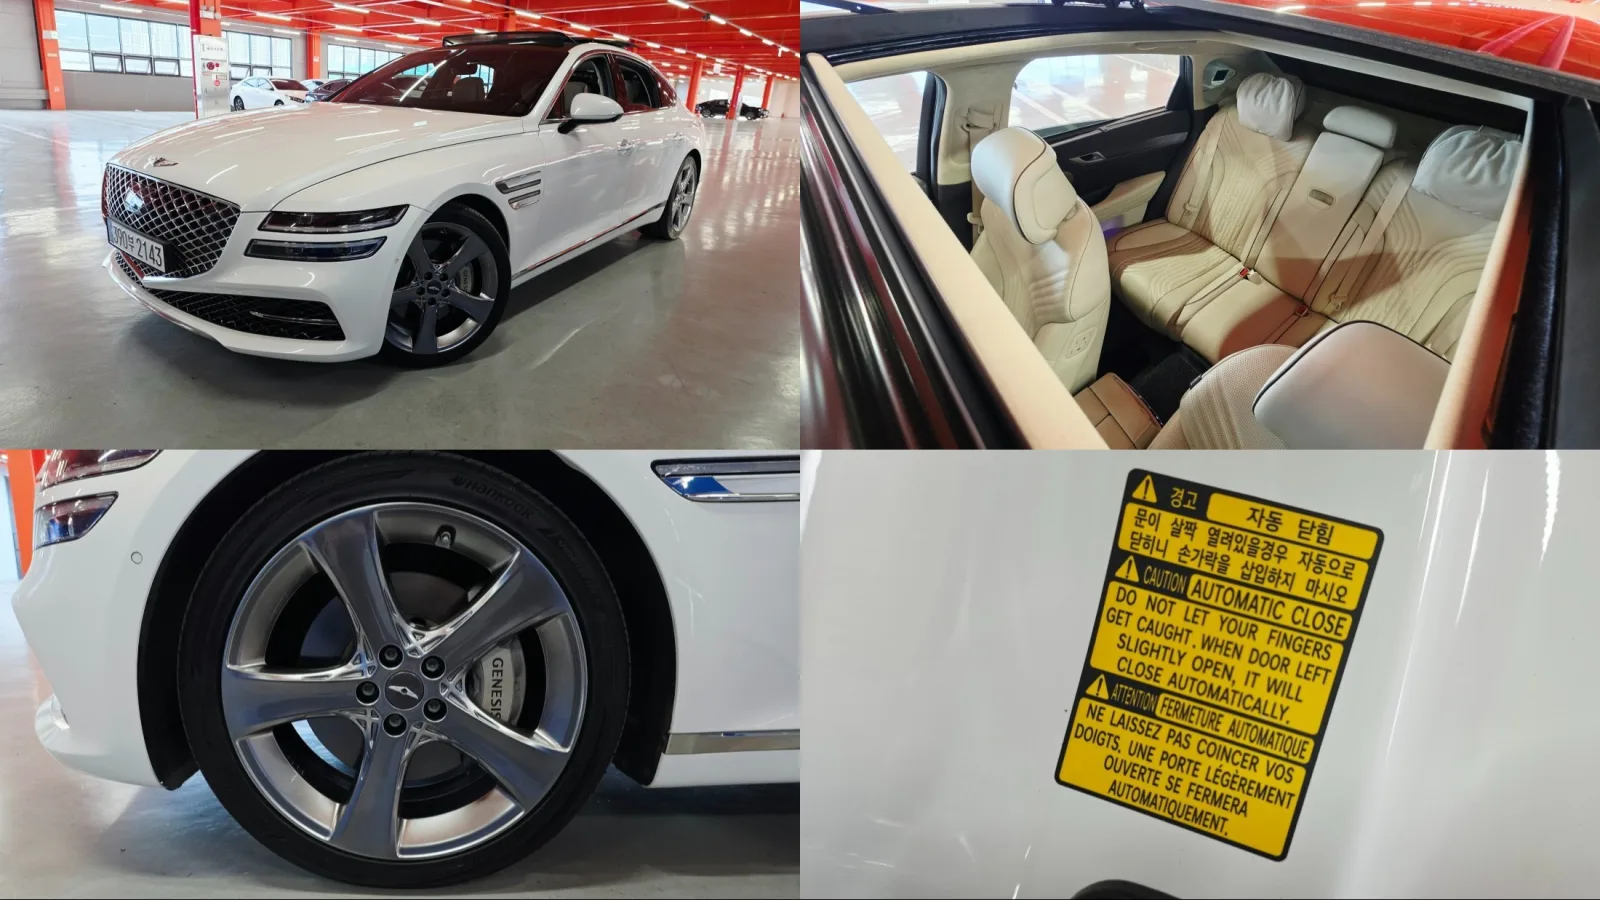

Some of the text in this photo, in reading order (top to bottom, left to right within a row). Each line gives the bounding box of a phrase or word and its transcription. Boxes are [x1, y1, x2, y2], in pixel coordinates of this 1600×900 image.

[113, 226, 163, 267] 390부 2143
[1134, 507, 1355, 580] 문이 살짝 열려있을경우 자동으로
[1170, 487, 1334, 545] 경고 자동 닫힘
[1129, 530, 1347, 603] 닫히니 손가락을 삽입하지 마시오
[1143, 565, 1347, 636] CAUTION AUTOMATIC CLOSE
[1106, 606, 1132, 627] GET
[1201, 633, 1243, 660] WHEN
[1247, 647, 1290, 674] DOOR
[1295, 661, 1331, 684] LEFT
[1115, 586, 1332, 660] DO NOT LET YOUR FINGERS
[490, 657, 504, 719] GENESIS
[1116, 632, 1302, 702] SLIGHTLY OPEN, IT WILL
[1116, 656, 1289, 724] CLOSE AUTOMATICALLY.
[1086, 703, 1294, 783] NE LAISSEZ PAS COINCER VOS
[1110, 683, 1309, 759] ATTENTION FERMETURE AUTOMATIQUE
[1103, 754, 1247, 817] OUVERTE SE FERMERA
[1107, 779, 1228, 836] AUTOMATIQUEMENT.
[1128, 740, 1155, 762] UNE
[1159, 750, 1201, 777] PORTE
[1204, 764, 1295, 808] LÉGÈREMENT
